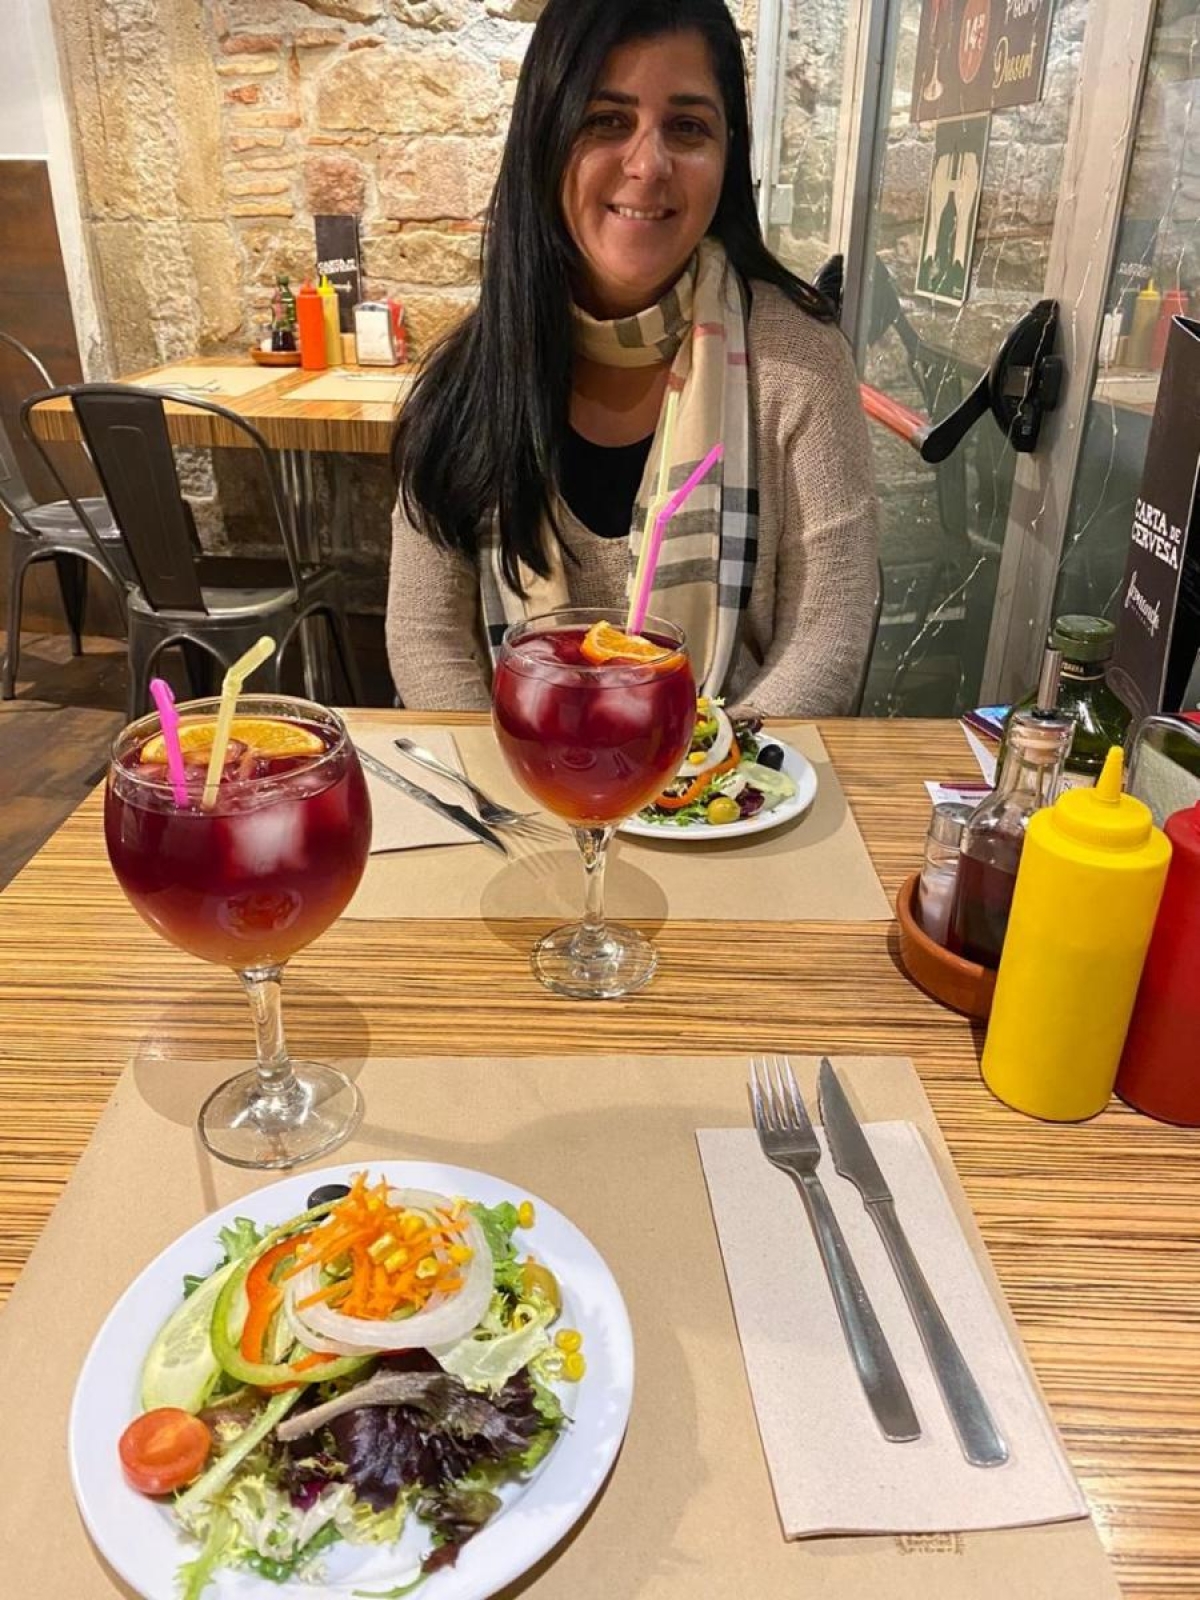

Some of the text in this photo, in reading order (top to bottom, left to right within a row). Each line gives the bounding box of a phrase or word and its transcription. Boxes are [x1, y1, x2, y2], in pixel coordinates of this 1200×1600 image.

[1131, 520, 1179, 570] CERVESA
[1135, 497, 1183, 545] CARTA DE
